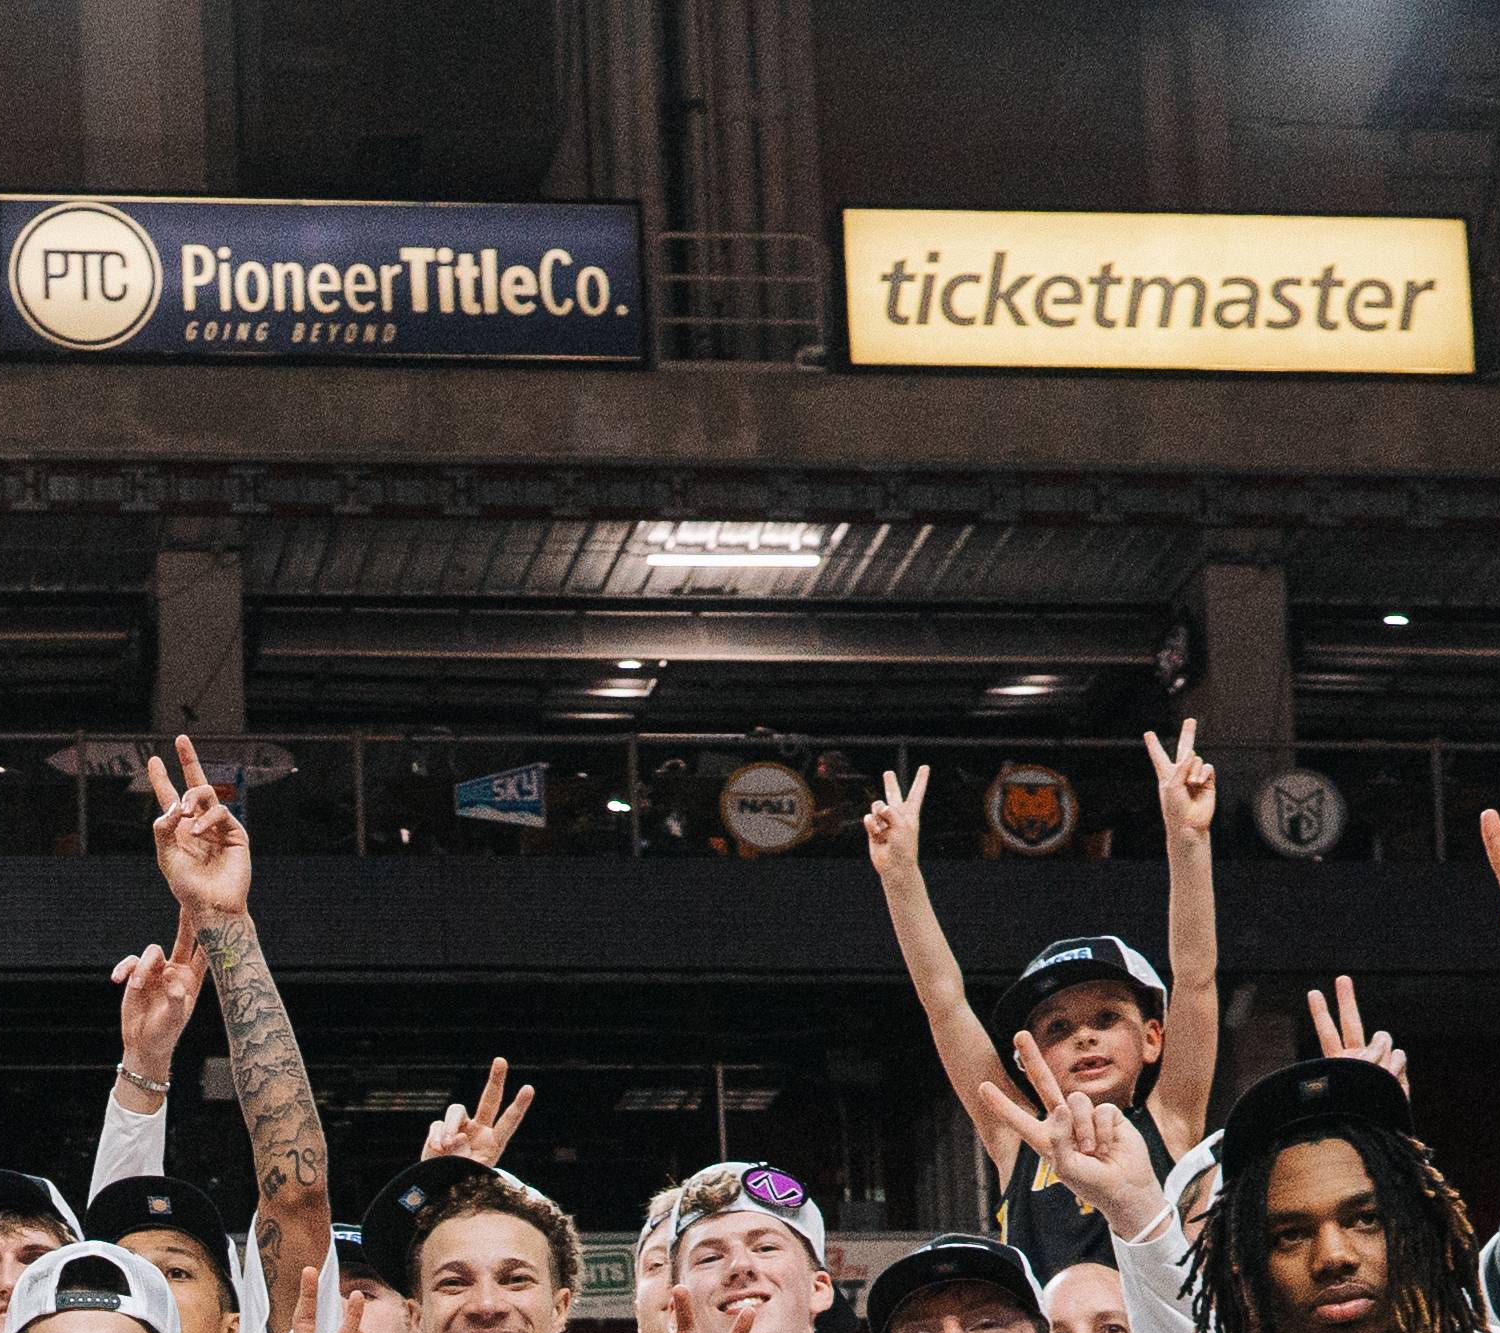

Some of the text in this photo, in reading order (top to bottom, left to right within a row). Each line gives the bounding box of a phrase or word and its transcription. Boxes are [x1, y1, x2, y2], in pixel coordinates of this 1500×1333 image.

[43, 249, 128, 302] PTC
[181, 245, 629, 317] PioneerTitleCo.
[880, 251, 1437, 331] ticketmaster
[184, 321, 397, 344] GOING BEYOND
[491, 769, 538, 801] SKY
